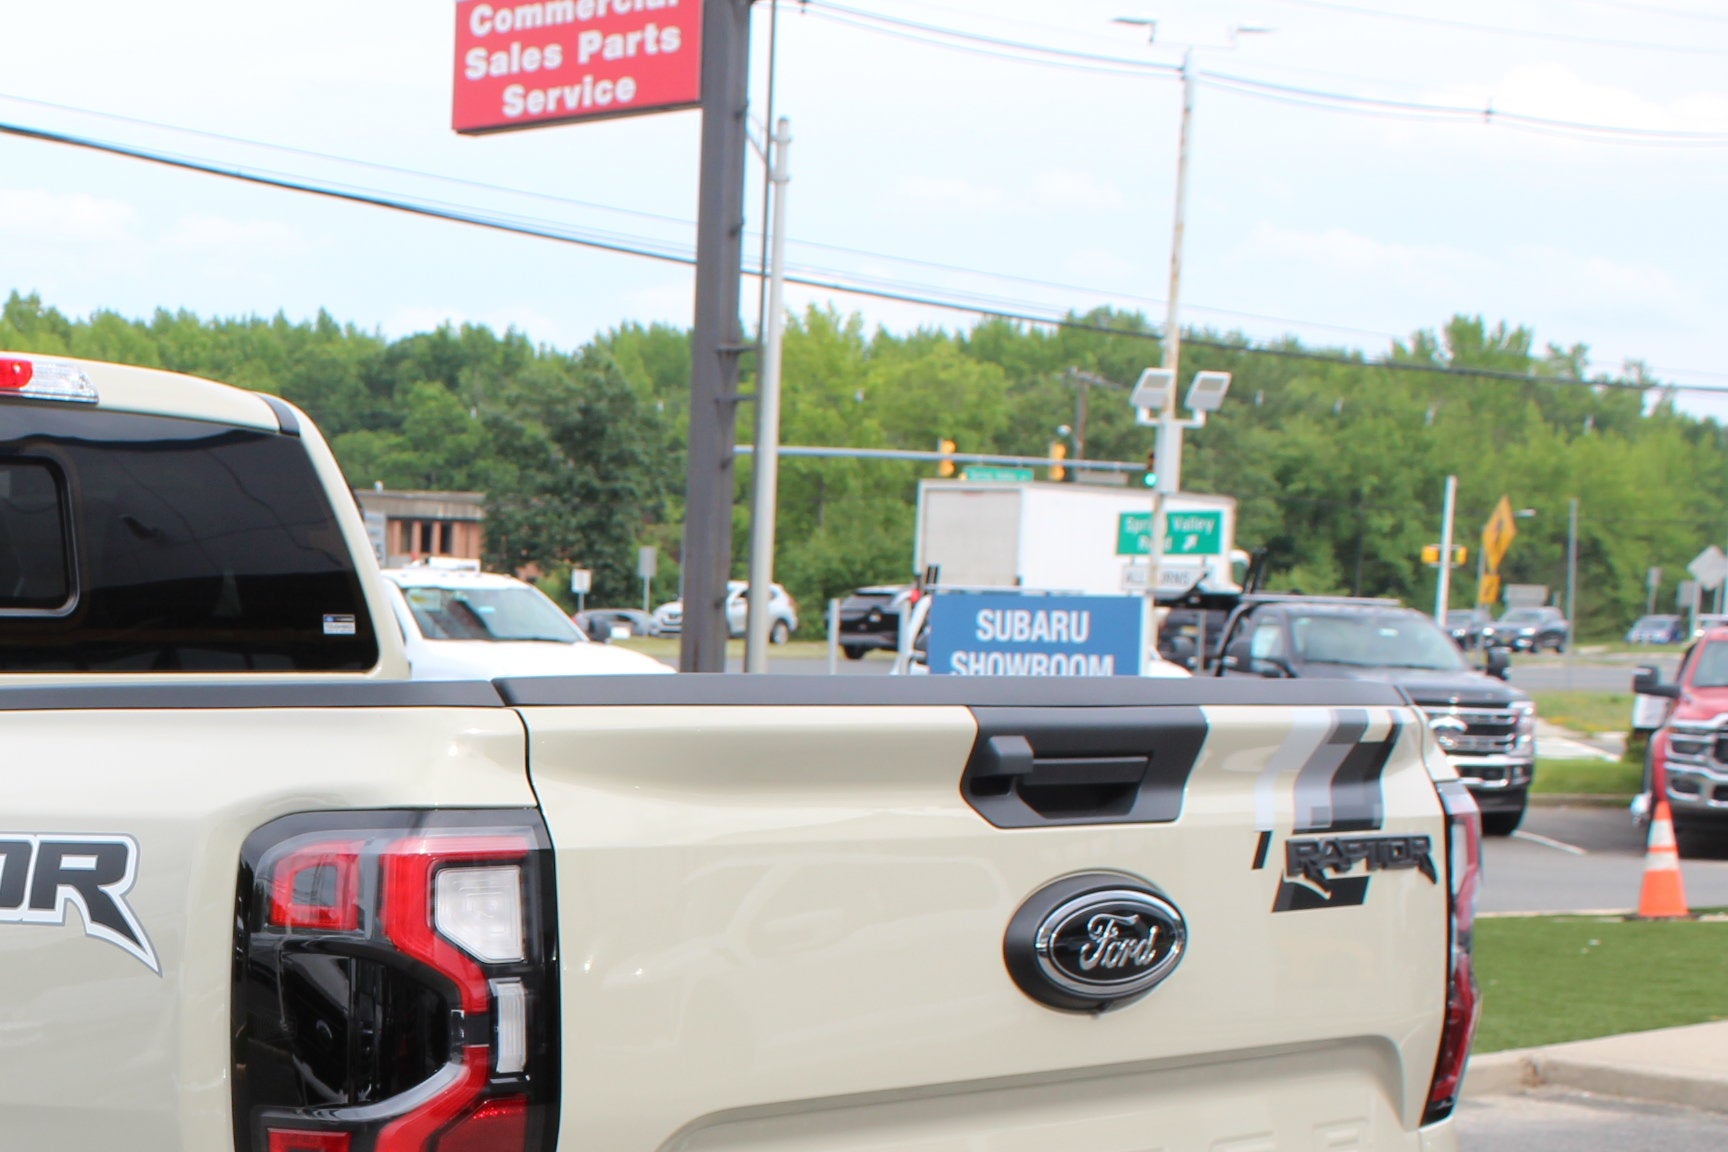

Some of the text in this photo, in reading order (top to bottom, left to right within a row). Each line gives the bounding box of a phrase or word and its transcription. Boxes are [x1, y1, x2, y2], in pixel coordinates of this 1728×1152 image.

[470, 0, 681, 37] Commerc
[464, 23, 682, 80] Sales Parts
[502, 74, 637, 118] Service
[1173, 516, 1216, 536] Valley
[975, 608, 1091, 643] SUBARU
[949, 651, 1115, 676] SHOWROOM
[1285, 835, 1438, 896] RAPTOR
[1079, 913, 1160, 970] Ford
